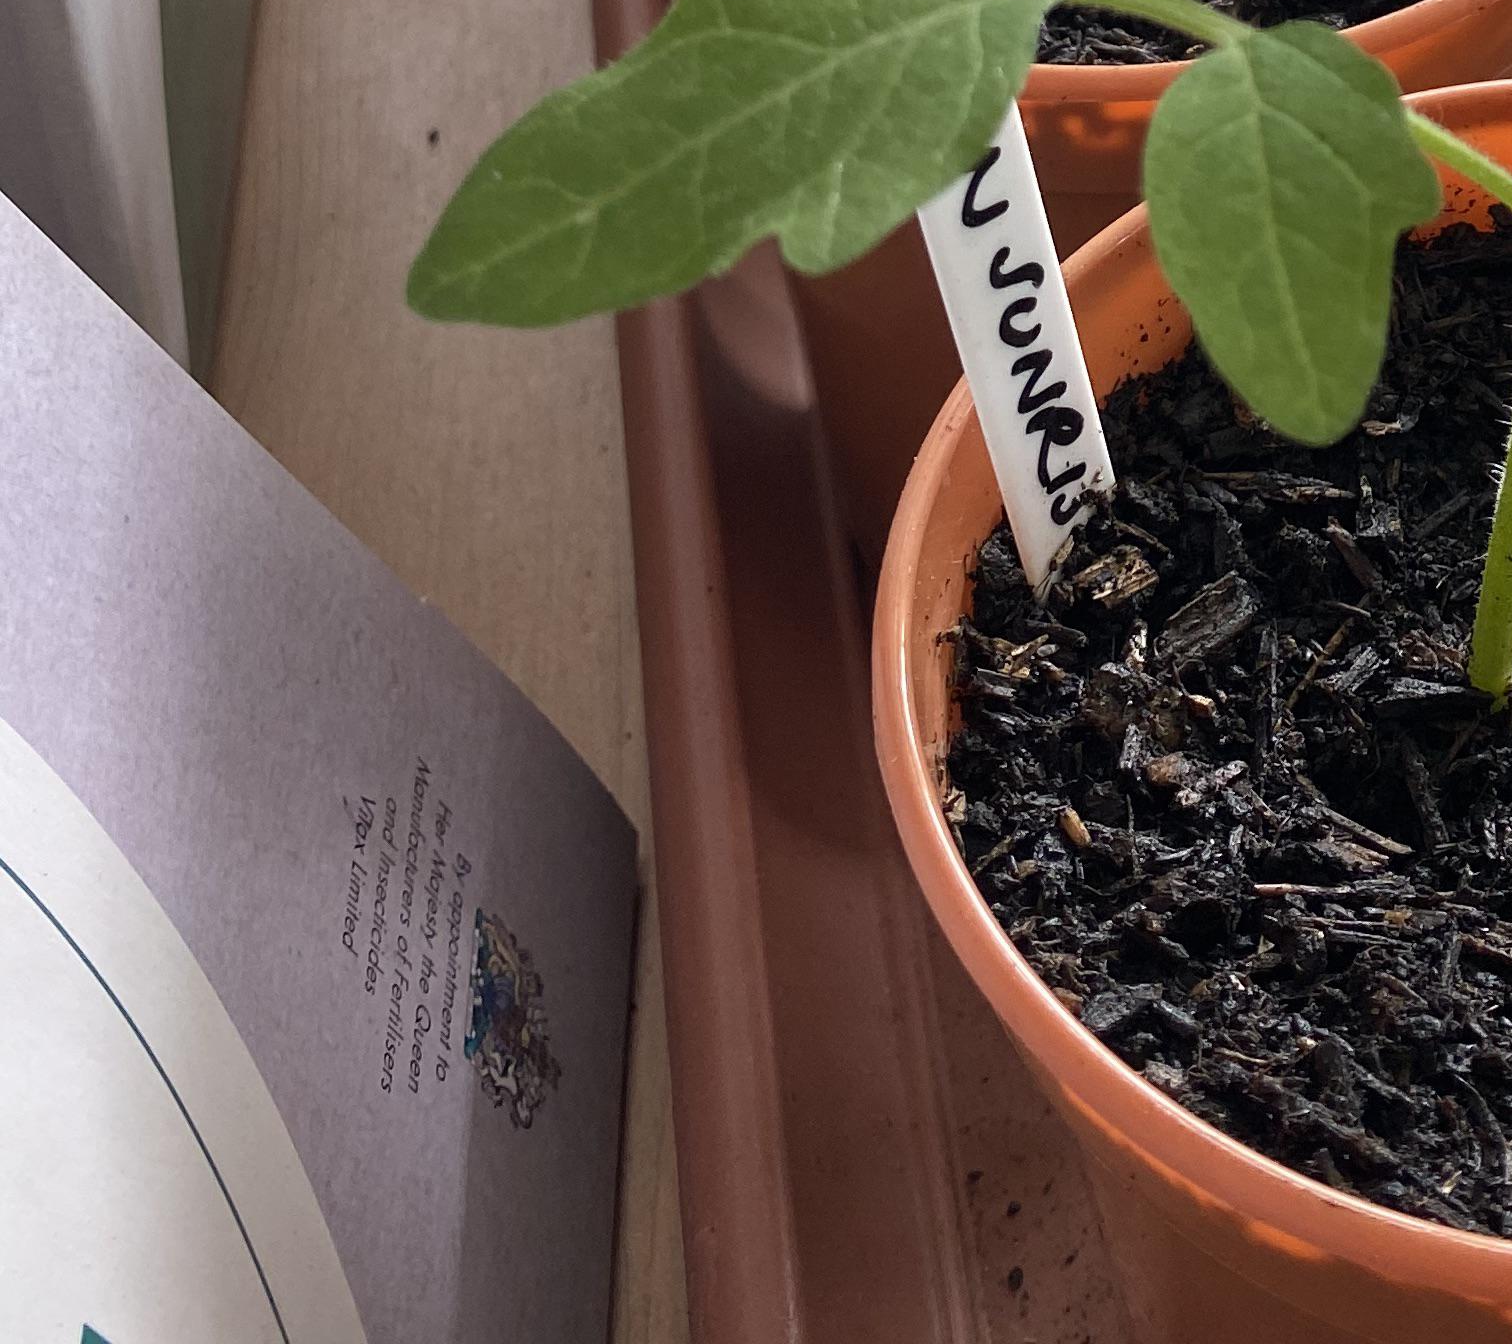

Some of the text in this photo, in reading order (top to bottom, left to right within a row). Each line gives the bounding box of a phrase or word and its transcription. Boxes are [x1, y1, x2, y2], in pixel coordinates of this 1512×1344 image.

[989, 244, 1093, 529] SUNRIS
[341, 859, 368, 958] Limited
[364, 797, 400, 996] and Insecticides
[380, 755, 432, 1095] Manufacturers of Fertilisers
[407, 799, 453, 1095] Her Majesty the Queen
[435, 852, 472, 1083] By appointment to
